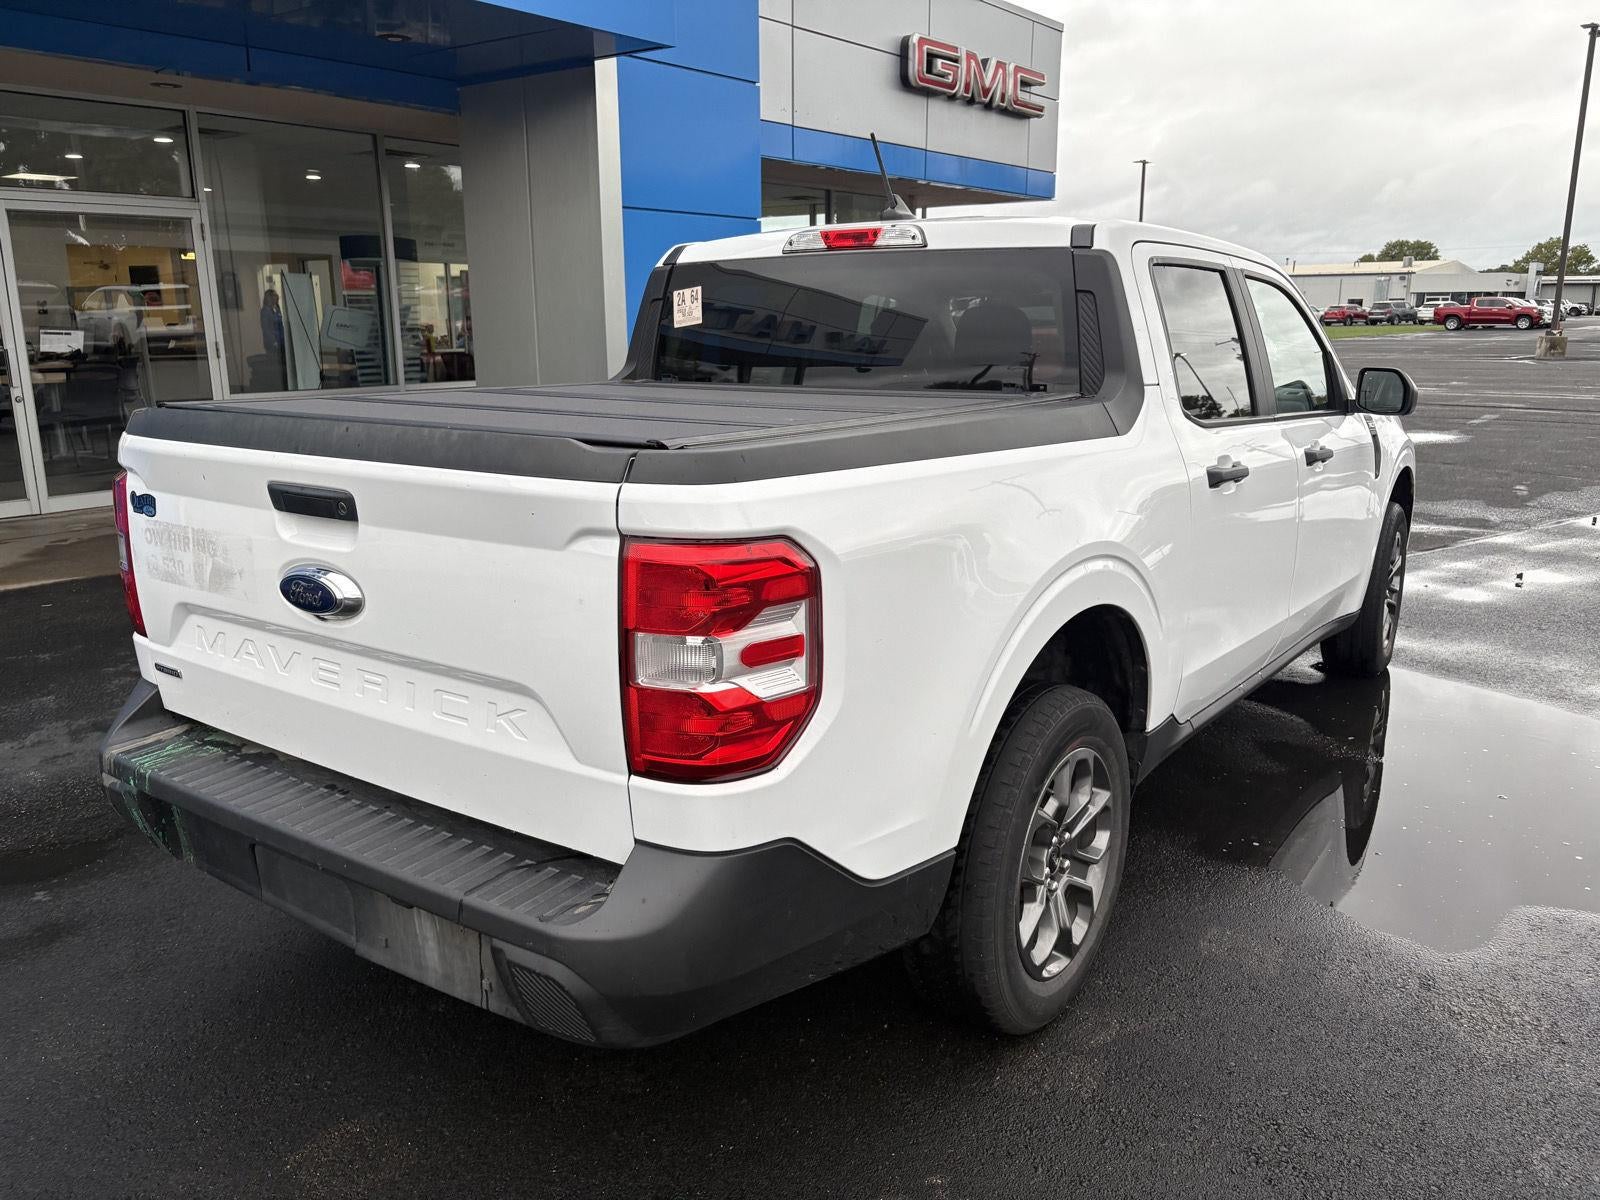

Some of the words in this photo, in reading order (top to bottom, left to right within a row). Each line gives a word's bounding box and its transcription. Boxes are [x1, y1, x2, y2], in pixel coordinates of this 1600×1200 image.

[902, 33, 1046, 118] GMC
[676, 291, 686, 307] 2A
[690, 289, 699, 305] 64
[289, 579, 322, 606] Ford
[195, 625, 529, 741] MAVERICK
